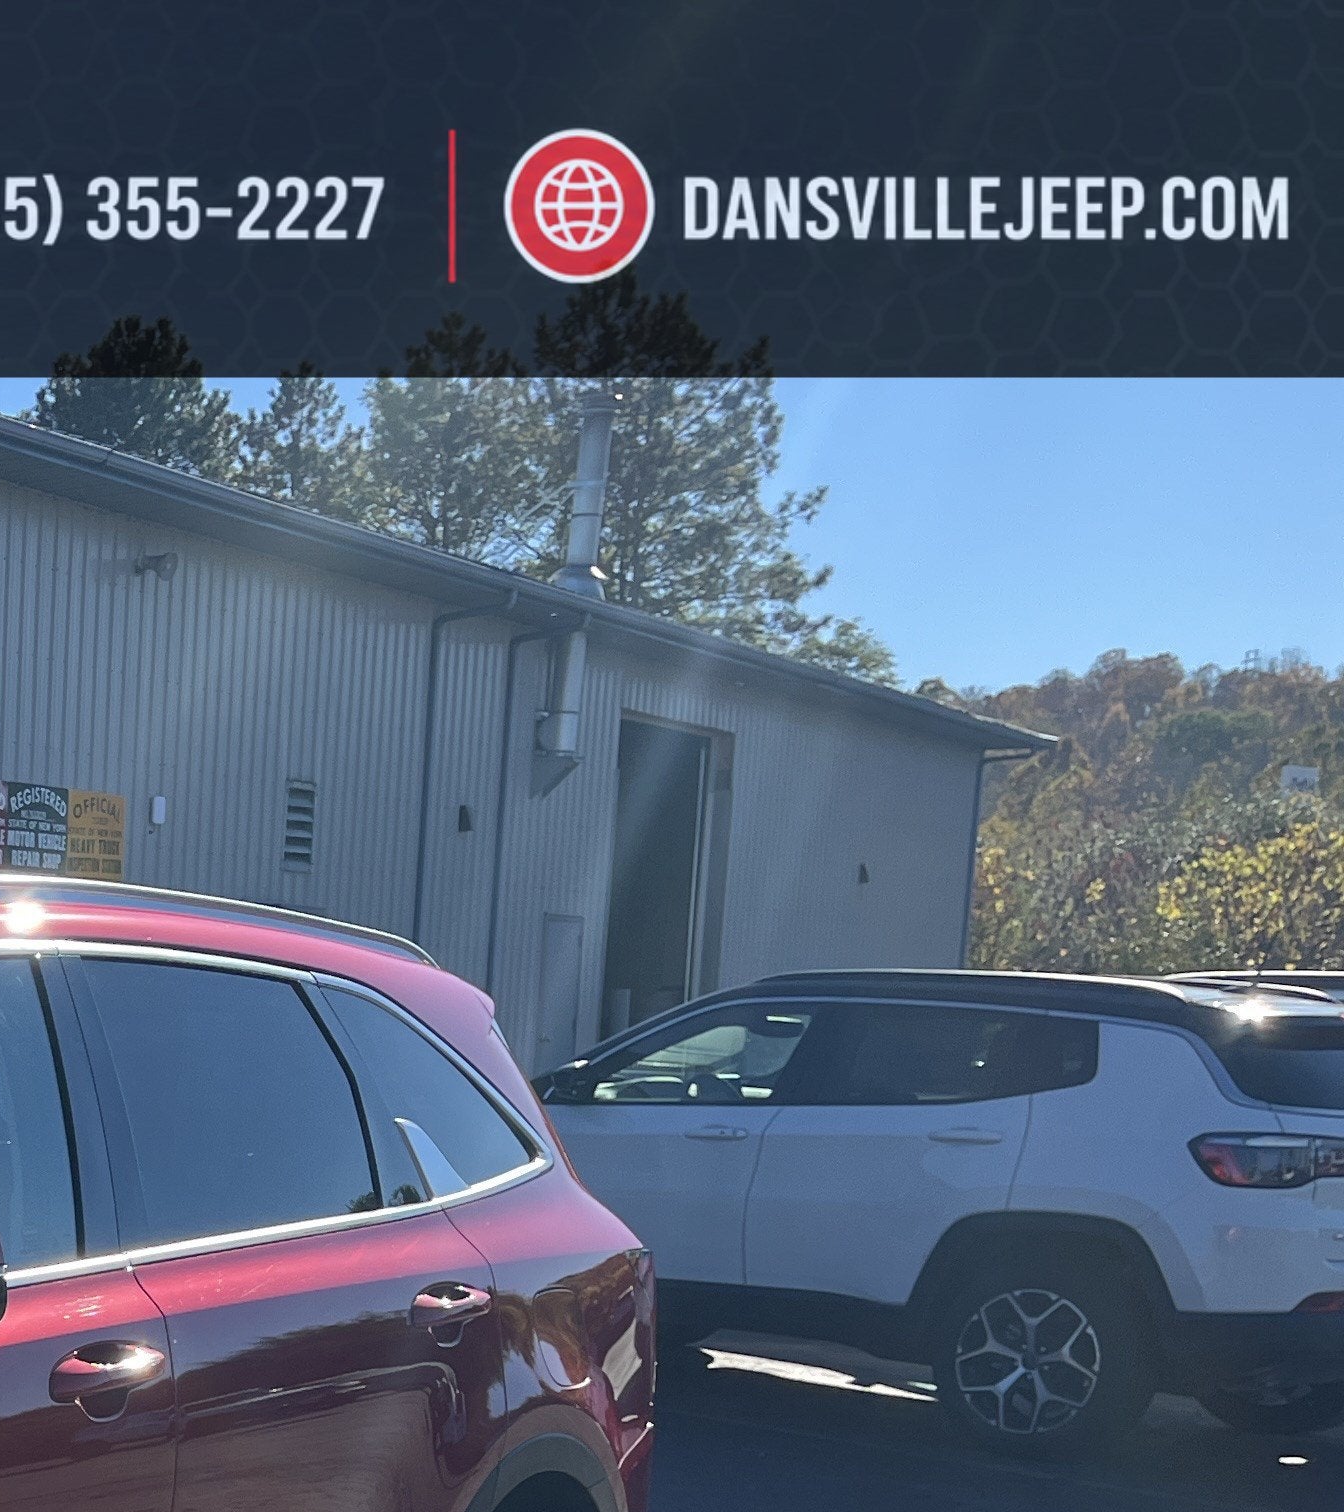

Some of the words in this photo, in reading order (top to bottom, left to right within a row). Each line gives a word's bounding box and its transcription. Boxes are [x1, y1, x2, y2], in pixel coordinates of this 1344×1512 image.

[9, 786, 67, 818] REGISTERED
[73, 797, 121, 825] OFFICIAL
[8, 819, 27, 829] STATE
[28, 820, 38, 830] OF
[38, 821, 51, 831] NEW
[7, 829, 35, 848] MOTOR
[37, 832, 67, 851] VEHICLE
[11, 849, 40, 868] REPAIR
[42, 852, 62, 870] SHOP
